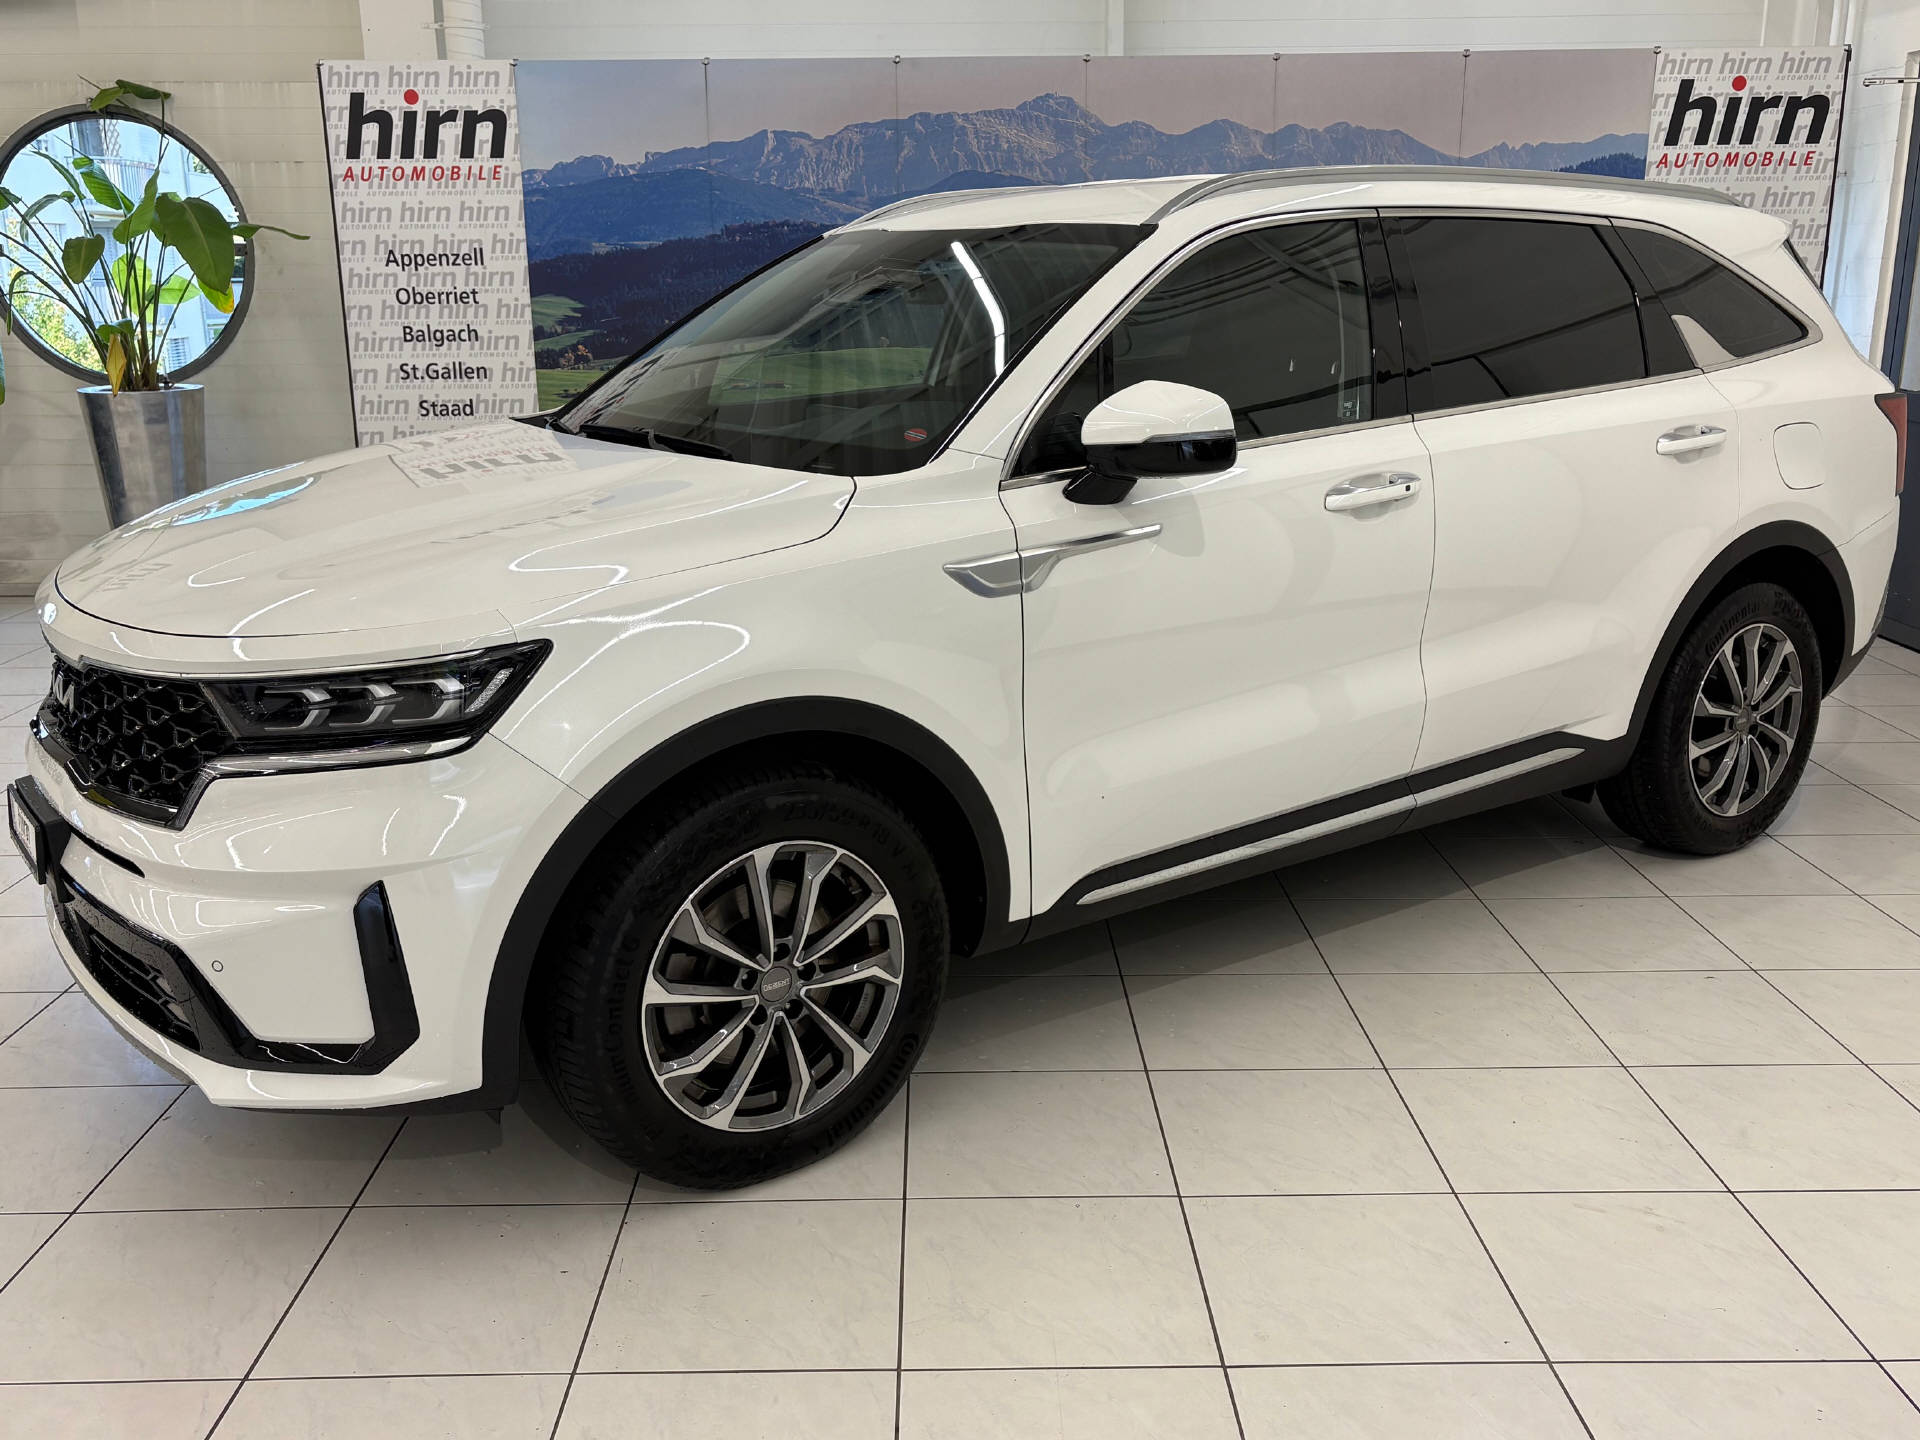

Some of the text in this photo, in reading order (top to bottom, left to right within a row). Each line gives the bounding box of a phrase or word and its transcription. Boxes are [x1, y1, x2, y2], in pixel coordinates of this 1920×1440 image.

[1660, 51, 1831, 75] hirn hirn hirn
[327, 65, 499, 88] hirn hirn hirn
[1664, 75, 1830, 146] hirn
[346, 89, 508, 159] hirn
[1656, 150, 1816, 168] AUTOMOBILE
[342, 165, 504, 182] AUTOMOBILE
[1762, 186, 1815, 208] hirn
[341, 200, 509, 223] hirn hirn hirn
[385, 247, 484, 272] Appenzell
[348, 265, 514, 288] hirn hirn hirn
[395, 286, 480, 305] Oberriet
[402, 323, 479, 347] Balgach
[400, 361, 488, 380] St.Gallen
[360, 394, 409, 415] hirn
[418, 398, 474, 417] Staad
[475, 393, 525, 414] hirn
